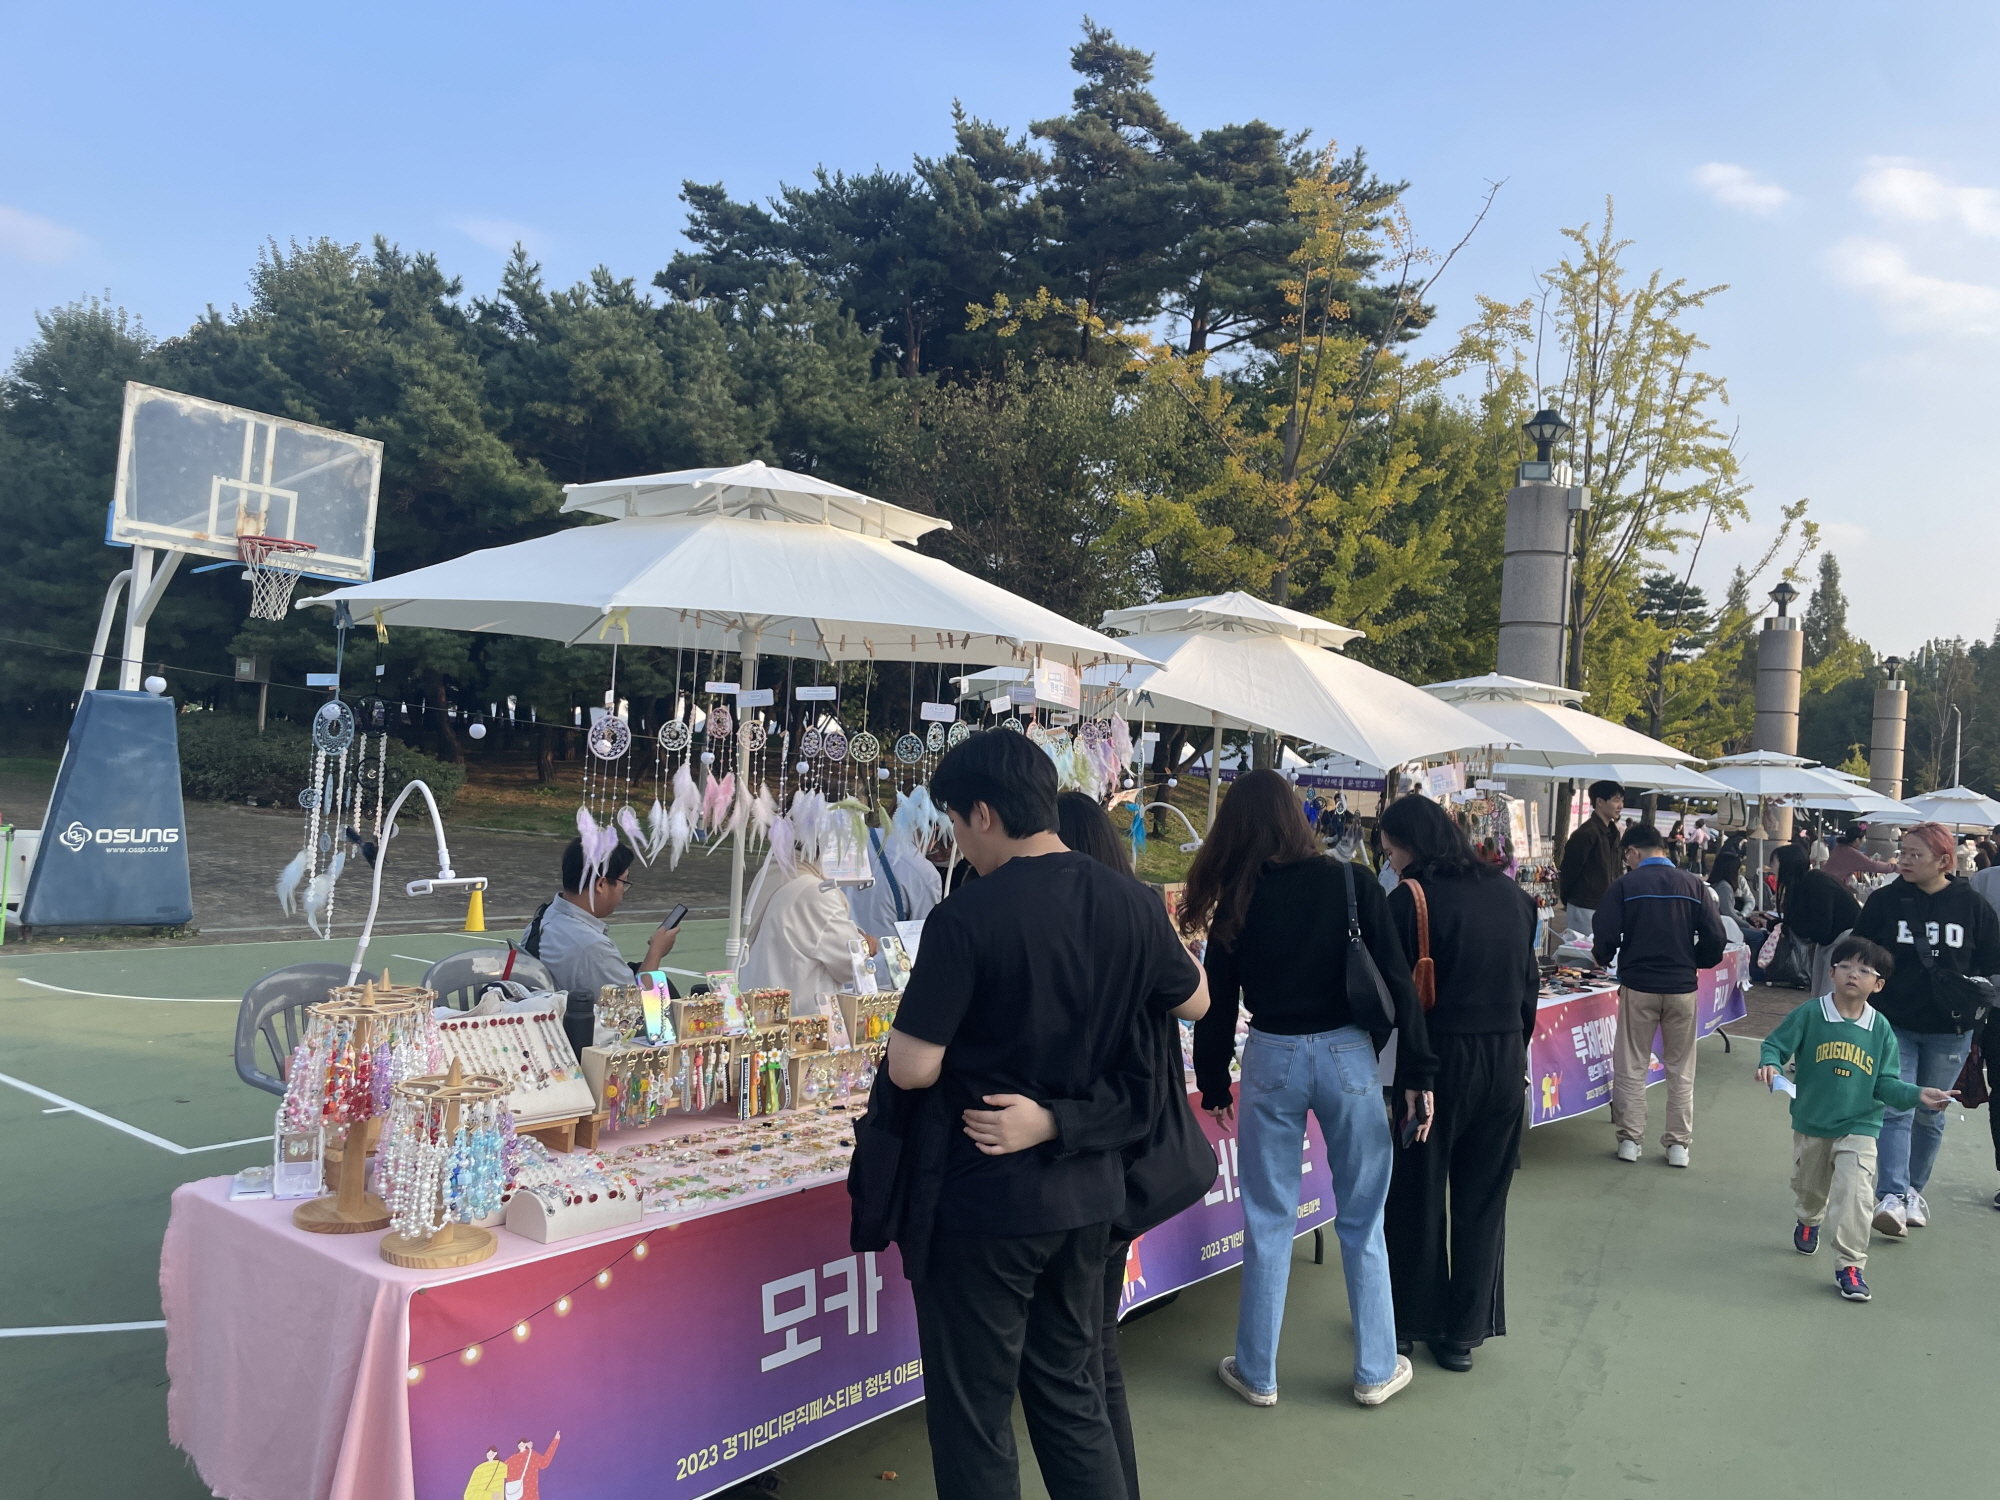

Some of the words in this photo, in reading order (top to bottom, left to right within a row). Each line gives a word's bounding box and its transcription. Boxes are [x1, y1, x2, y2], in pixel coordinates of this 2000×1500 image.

[95, 828, 179, 844] OSUNG
[105, 845, 169, 854] www.ossp.co.kr
[1815, 1041, 1874, 1076] ORIGINALS
[1200, 1240, 1221, 1261] 2023
[759, 1250, 884, 1373] 모카
[675, 1443, 719, 1482] 2023
[720, 1381, 863, 1461] 경기인디뮤직페스티벌
[864, 1365, 893, 1398] 청년
